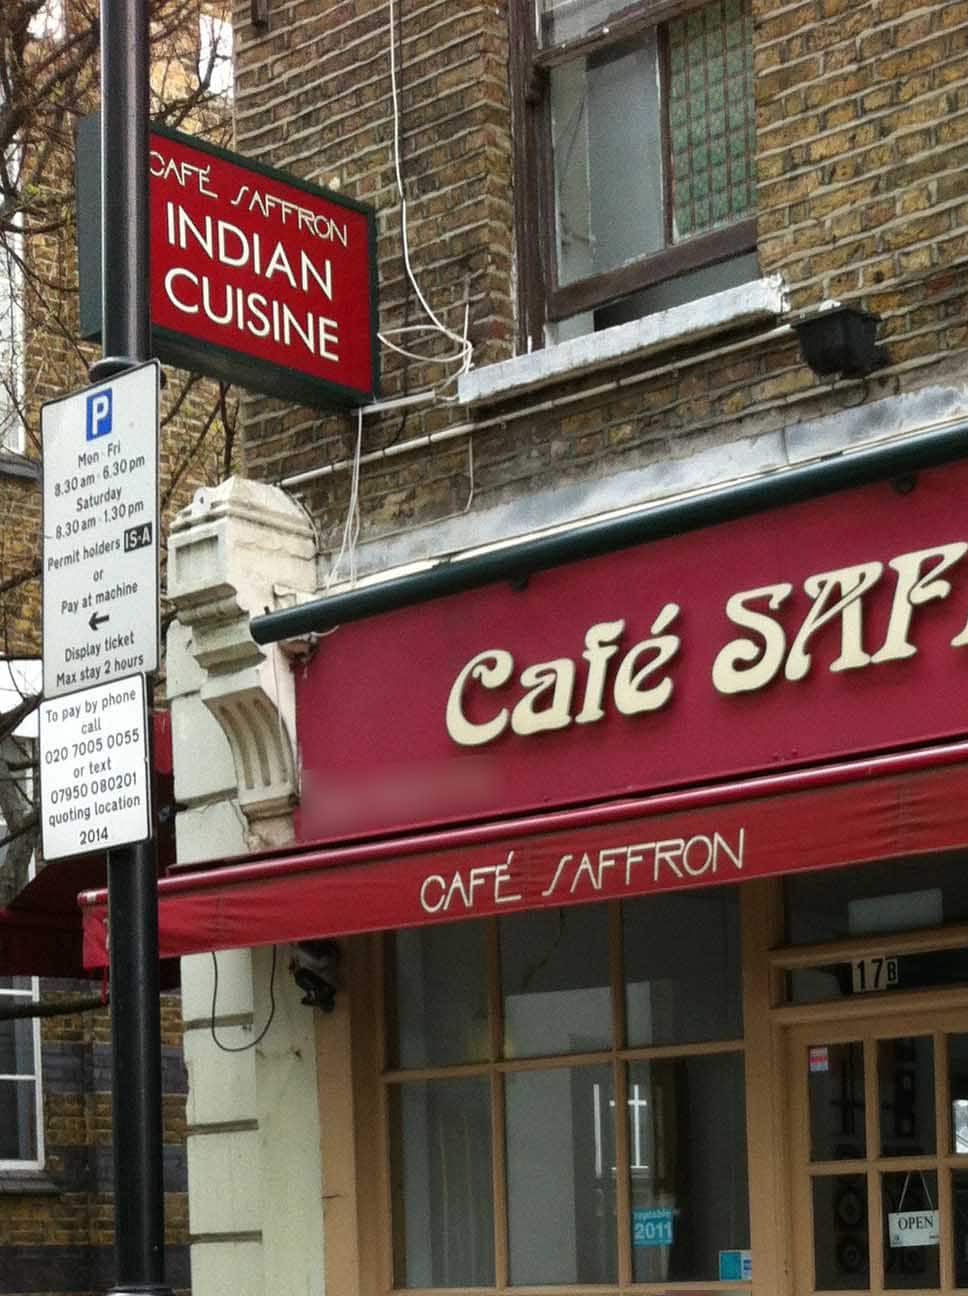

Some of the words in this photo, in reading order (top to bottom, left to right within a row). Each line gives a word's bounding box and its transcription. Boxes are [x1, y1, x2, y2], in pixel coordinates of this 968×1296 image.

[230, 185, 348, 249] SAFFRON
[166, 201, 334, 302] INDIAN
[164, 266, 340, 362] CUISINE
[91, 394, 109, 437] P
[78, 452, 100, 469] Mon
[107, 440, 121, 459] Fri
[54, 474, 79, 498] 8.30
[80, 471, 96, 488] am
[102, 458, 128, 481] 6.30
[129, 454, 145, 473] pm
[76, 486, 122, 513] Saturday
[55, 519, 80, 540] 8.30
[81, 514, 97, 532] am
[104, 502, 127, 524] 1.30
[128, 498, 144, 518] pm
[47, 547, 81, 572] Permit
[83, 536, 121, 562] holders
[93, 568, 104, 583] or
[61, 598, 79, 616] Pay
[82, 592, 93, 609] at
[95, 581, 138, 604] machine
[64, 639, 102, 663] Display
[104, 631, 135, 650] ticket
[56, 672, 78, 688] Max
[80, 664, 102, 682] stay
[104, 660, 112, 675] 2
[114, 652, 144, 673] hours
[445, 602, 681, 748] Café
[46, 708, 59, 724] To
[62, 704, 82, 722] pay
[84, 696, 99, 715] by
[102, 688, 137, 711] phone
[81, 717, 102, 735] call
[45, 746, 69, 765] 020
[72, 738, 104, 760] 7005
[106, 727, 140, 749] 0055
[73, 765, 85, 780] or
[89, 757, 112, 776] text
[51, 782, 89, 805] 07950
[91, 771, 138, 795] 080201
[49, 805, 91, 827] quoting
[94, 794, 141, 816] location
[79, 826, 109, 846] 2014
[420, 850, 522, 913] CAFÉ
[542, 827, 745, 896] SAFFRON
[633, 1221, 673, 1240] 2011
[897, 1215, 935, 1231] OPEN
